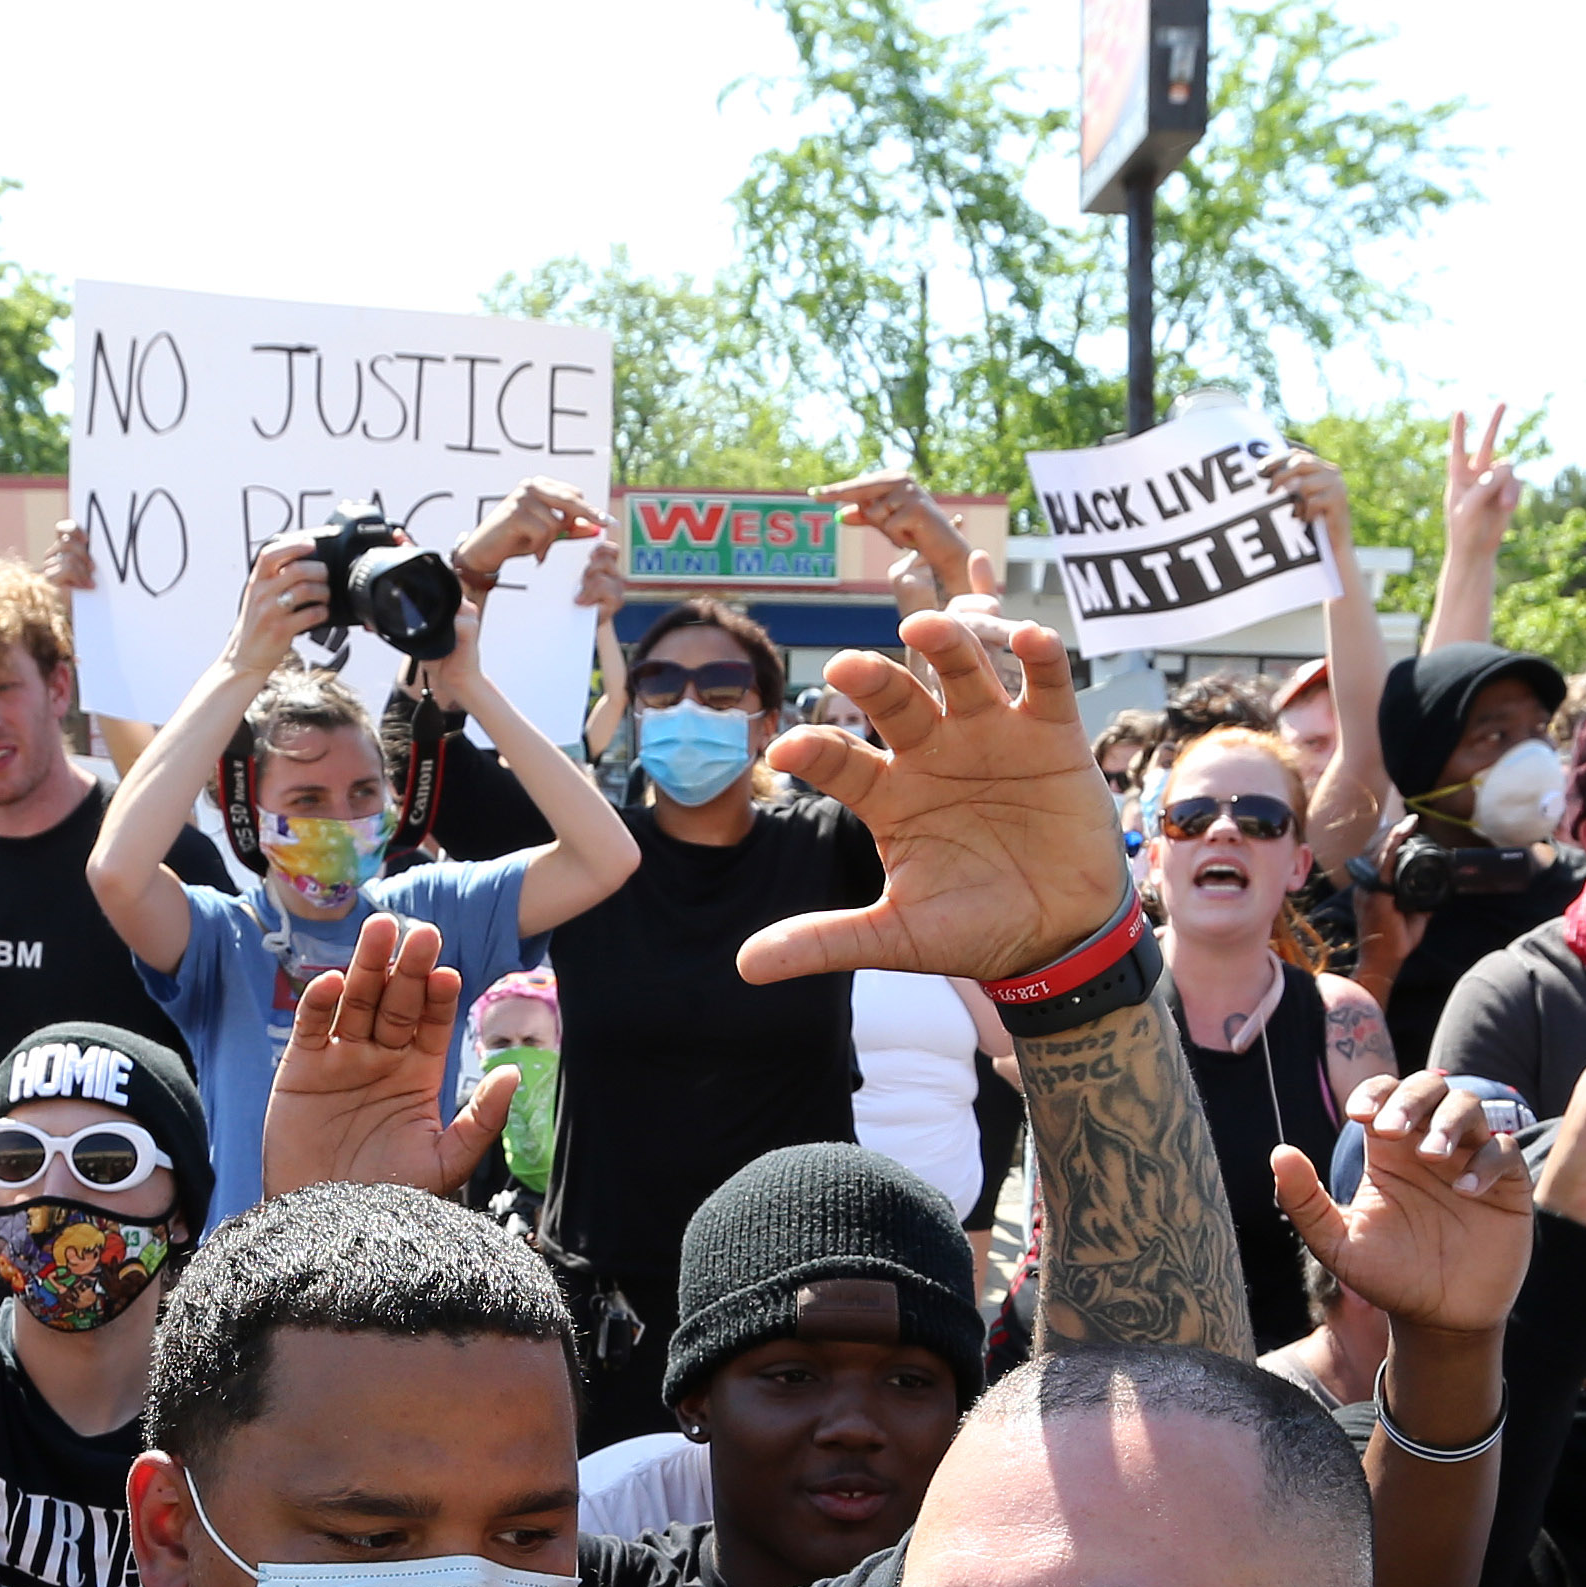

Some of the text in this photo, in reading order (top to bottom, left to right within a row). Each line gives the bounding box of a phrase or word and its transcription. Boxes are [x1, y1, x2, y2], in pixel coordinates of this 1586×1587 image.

[85, 329, 596, 455] NO JUSTICE
[85, 486, 190, 598] NO
[635, 499, 834, 548] WEST
[1066, 500, 1317, 614] MATTER
[635, 547, 835, 576] MINI MART
[409, 758, 434, 826] Canon
[8, 1042, 135, 1107] HOMIE
